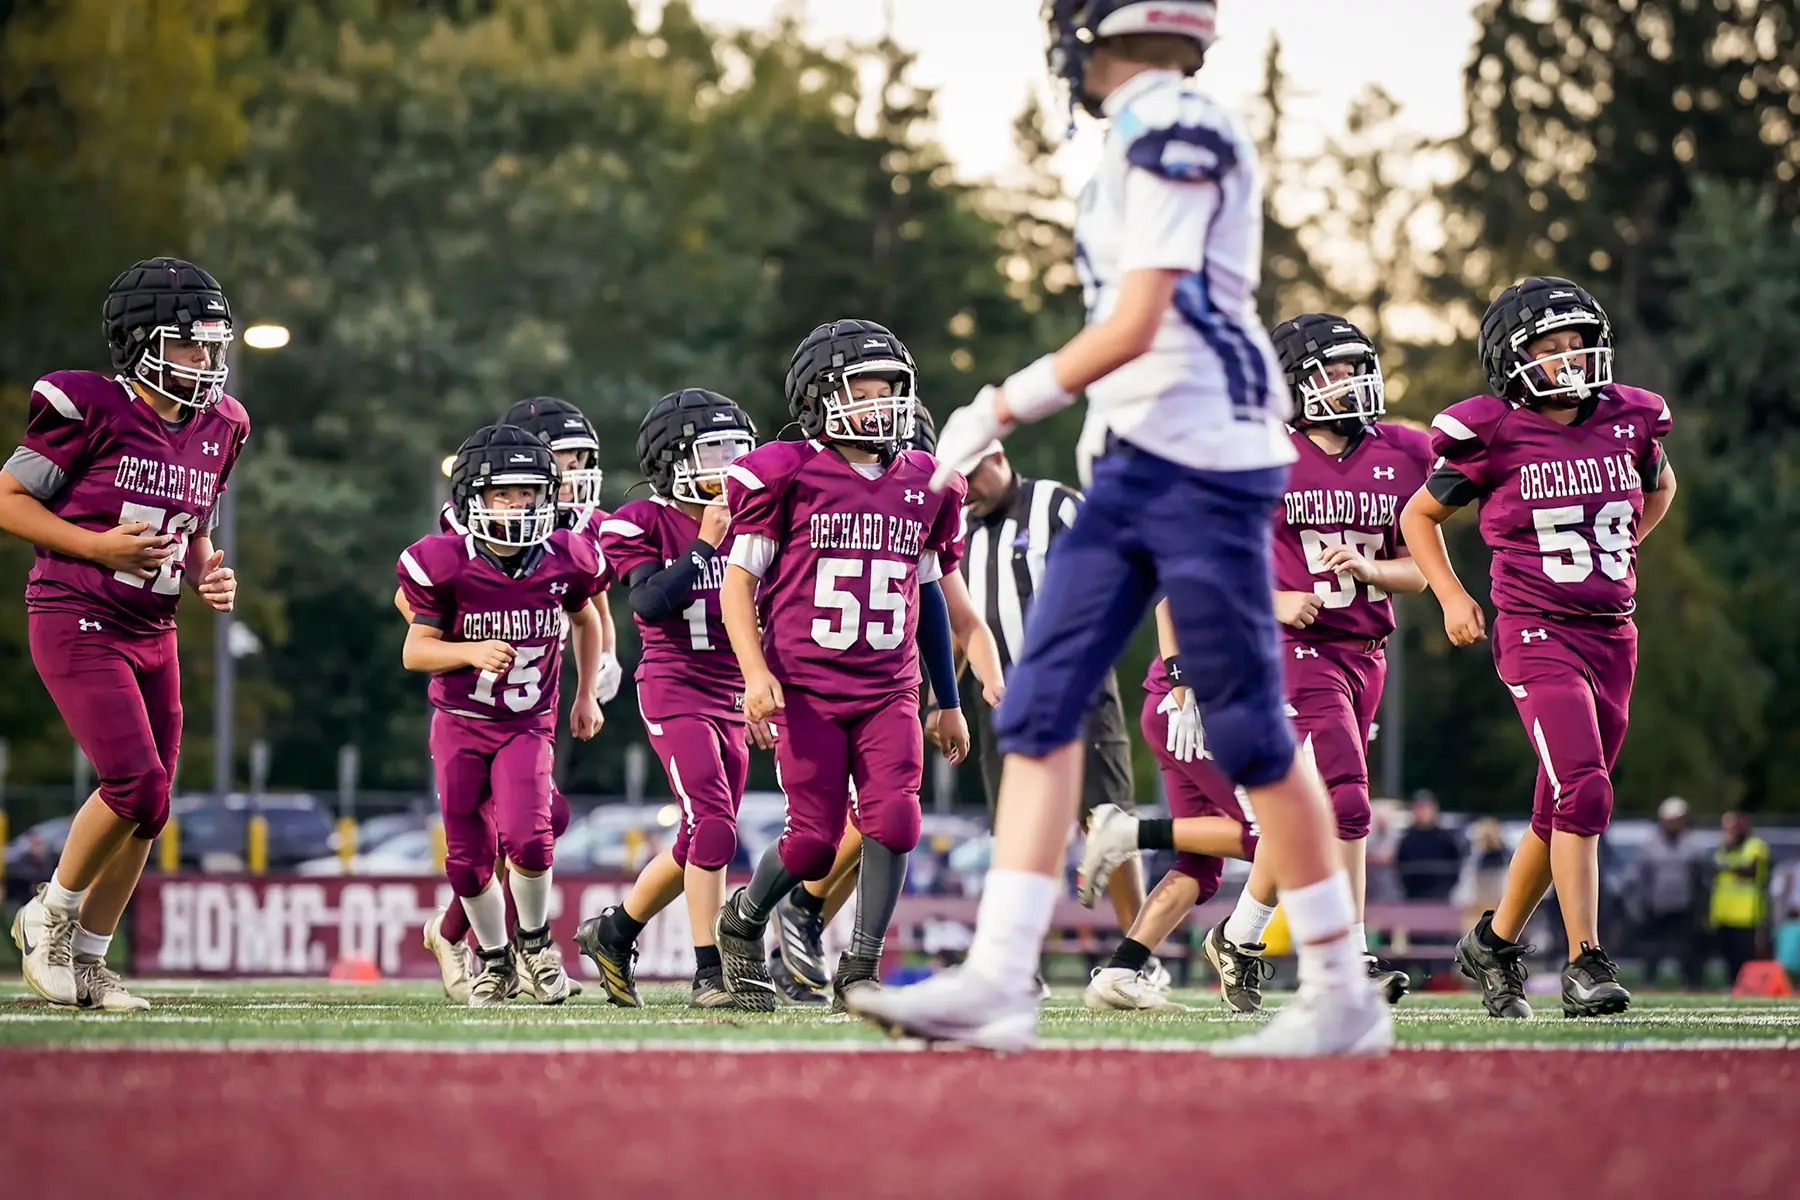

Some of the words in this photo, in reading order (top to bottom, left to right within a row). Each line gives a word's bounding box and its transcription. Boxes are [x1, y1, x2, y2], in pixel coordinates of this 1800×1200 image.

[114, 455, 186, 500] ORCHARD
[188, 468, 217, 507] PARK
[1520, 458, 1602, 500] ORCHARD
[1284, 489, 1355, 525] ORCHARD
[1359, 492, 1398, 526] PARK
[810, 513, 883, 550] ORCHARD
[888, 515, 922, 556] PARK
[1532, 499, 1635, 583] 59
[463, 609, 531, 640] ORCHARD
[535, 607, 561, 638] PAR
[683, 598, 725, 650] 1
[810, 557, 907, 651] 55
[468, 643, 548, 713] 15
[158, 882, 326, 972] HOME
